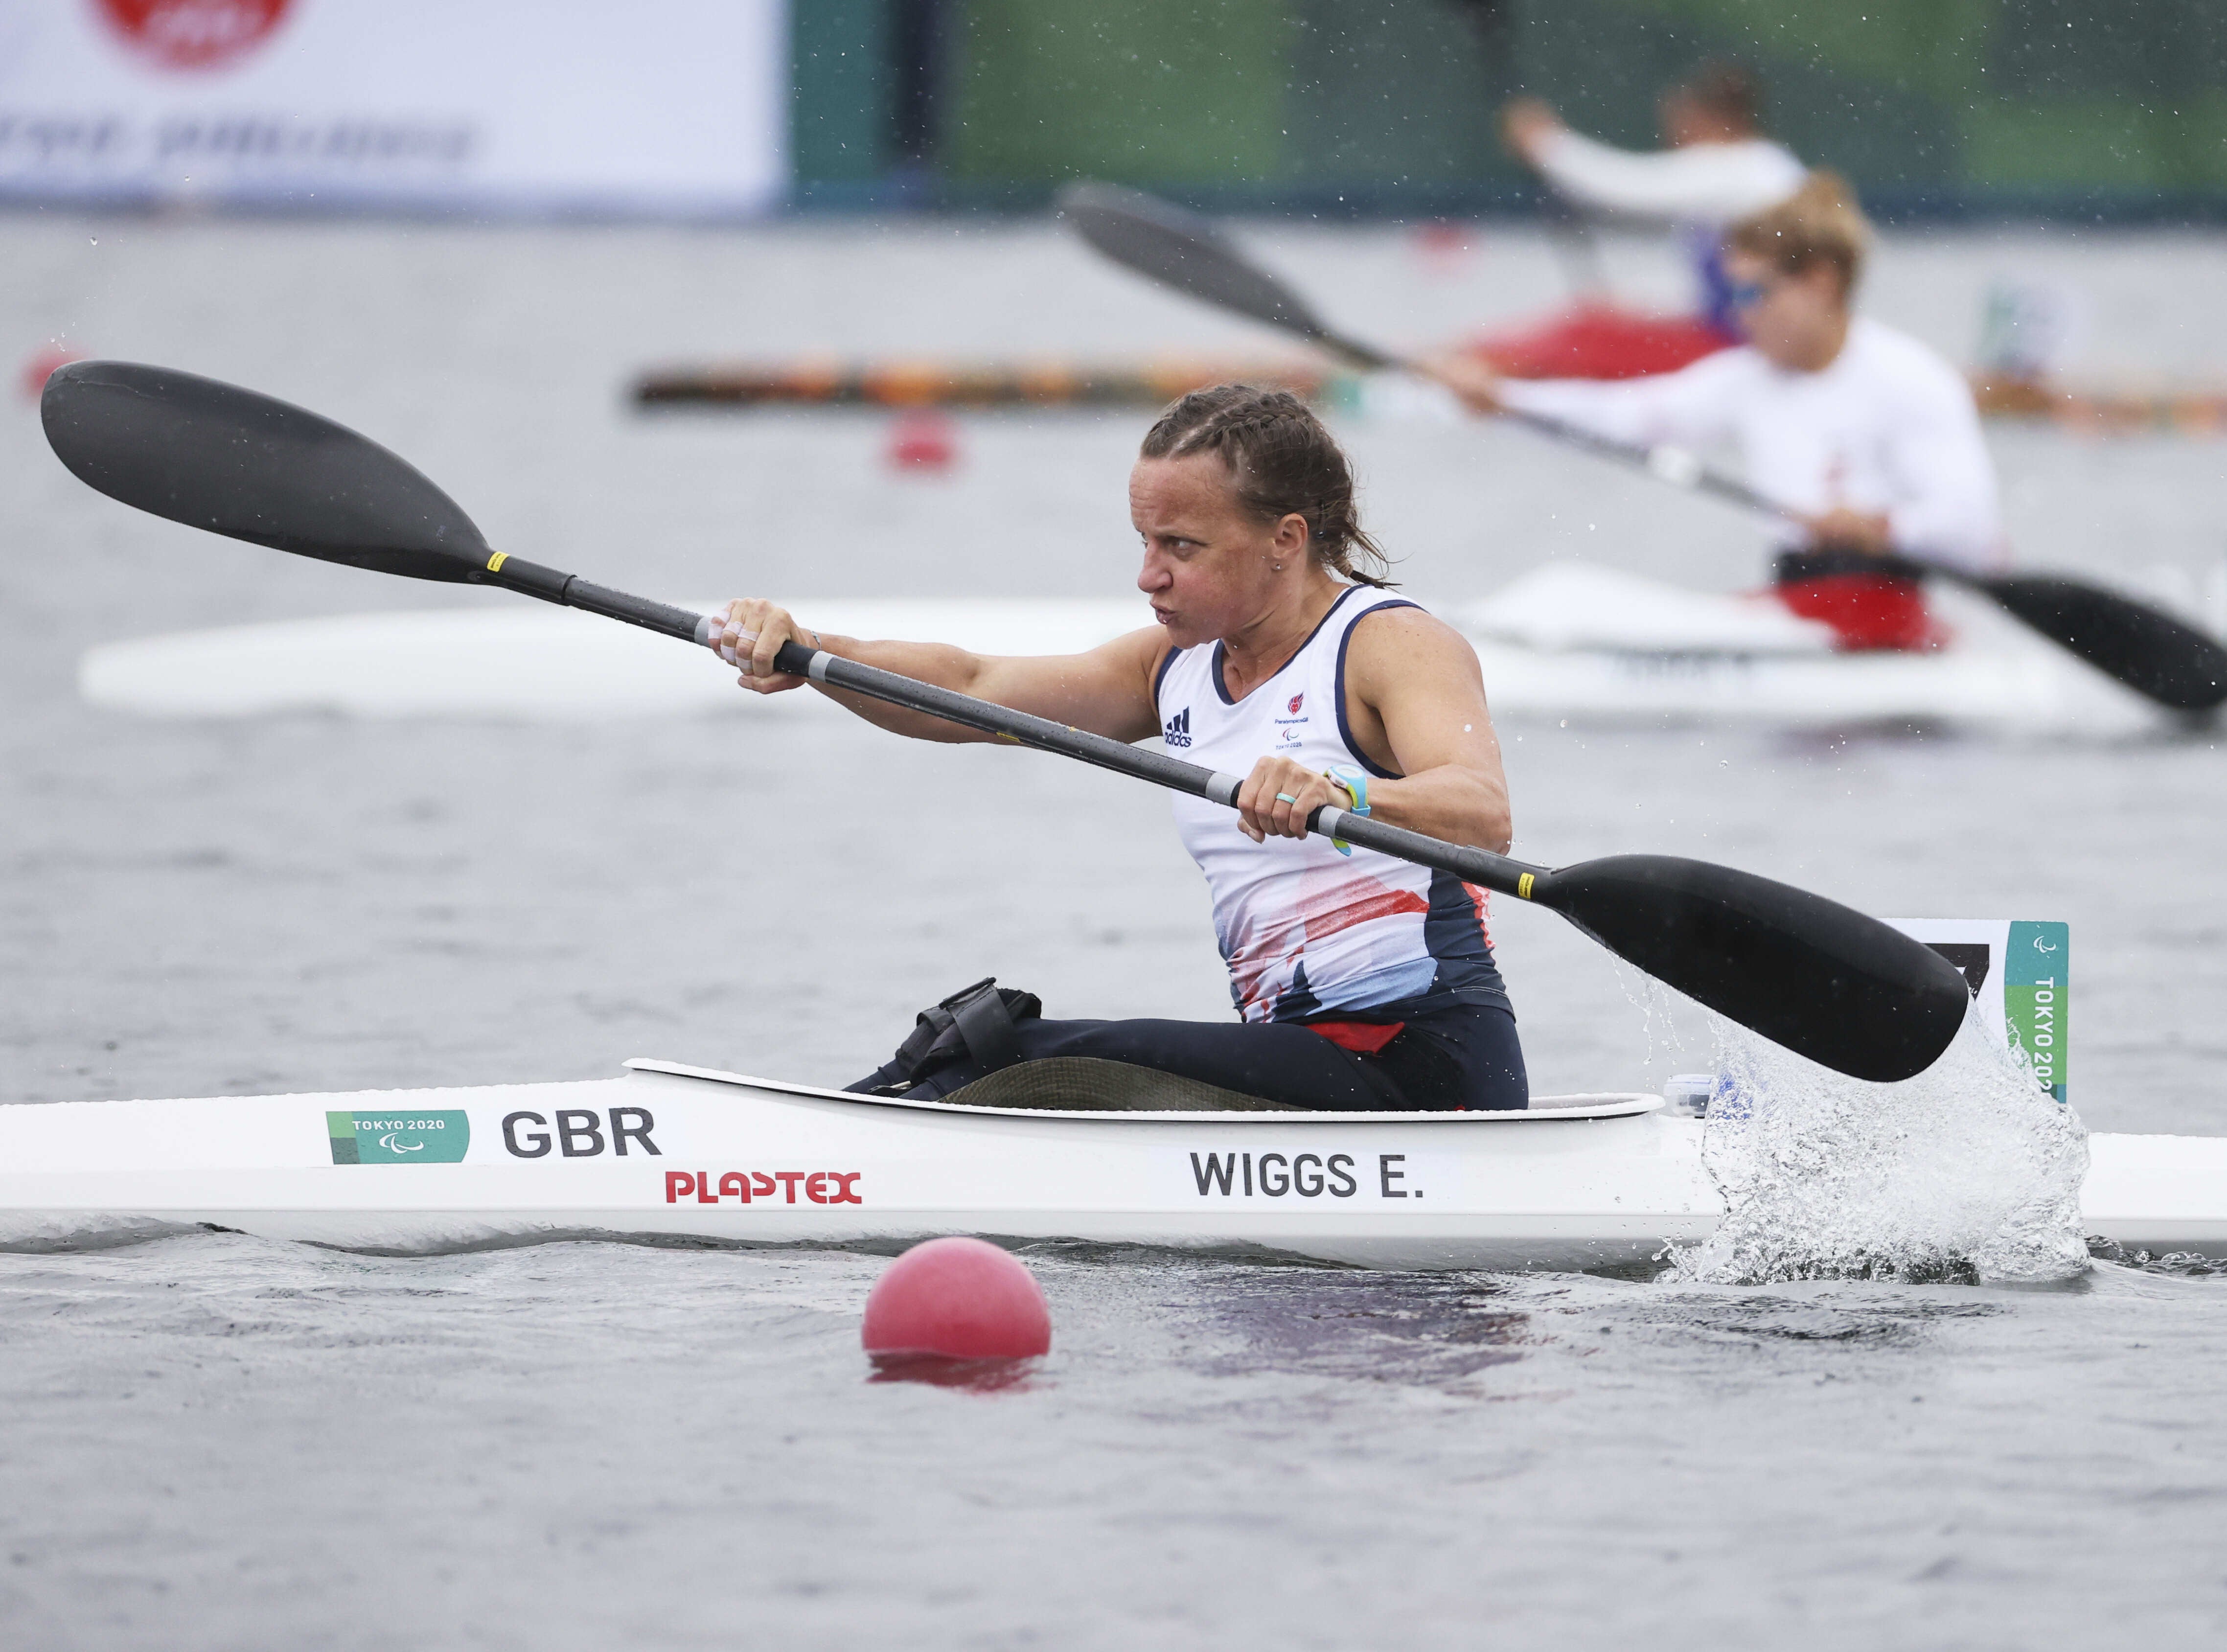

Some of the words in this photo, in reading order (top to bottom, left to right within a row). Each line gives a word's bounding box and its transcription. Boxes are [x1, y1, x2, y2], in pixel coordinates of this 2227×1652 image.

[1165, 730, 1192, 748] adidas
[2034, 976, 2054, 1047] TOKYO
[2034, 1052, 2053, 1090] 202
[352, 1120, 404, 1131] TOKYO
[407, 1120, 445, 1130] 2020
[502, 1107, 663, 1159] GBR
[666, 1171, 862, 1204] PLASTEX
[1190, 1152, 1357, 1198] WIGGS
[1379, 1155, 1423, 1198] E.
